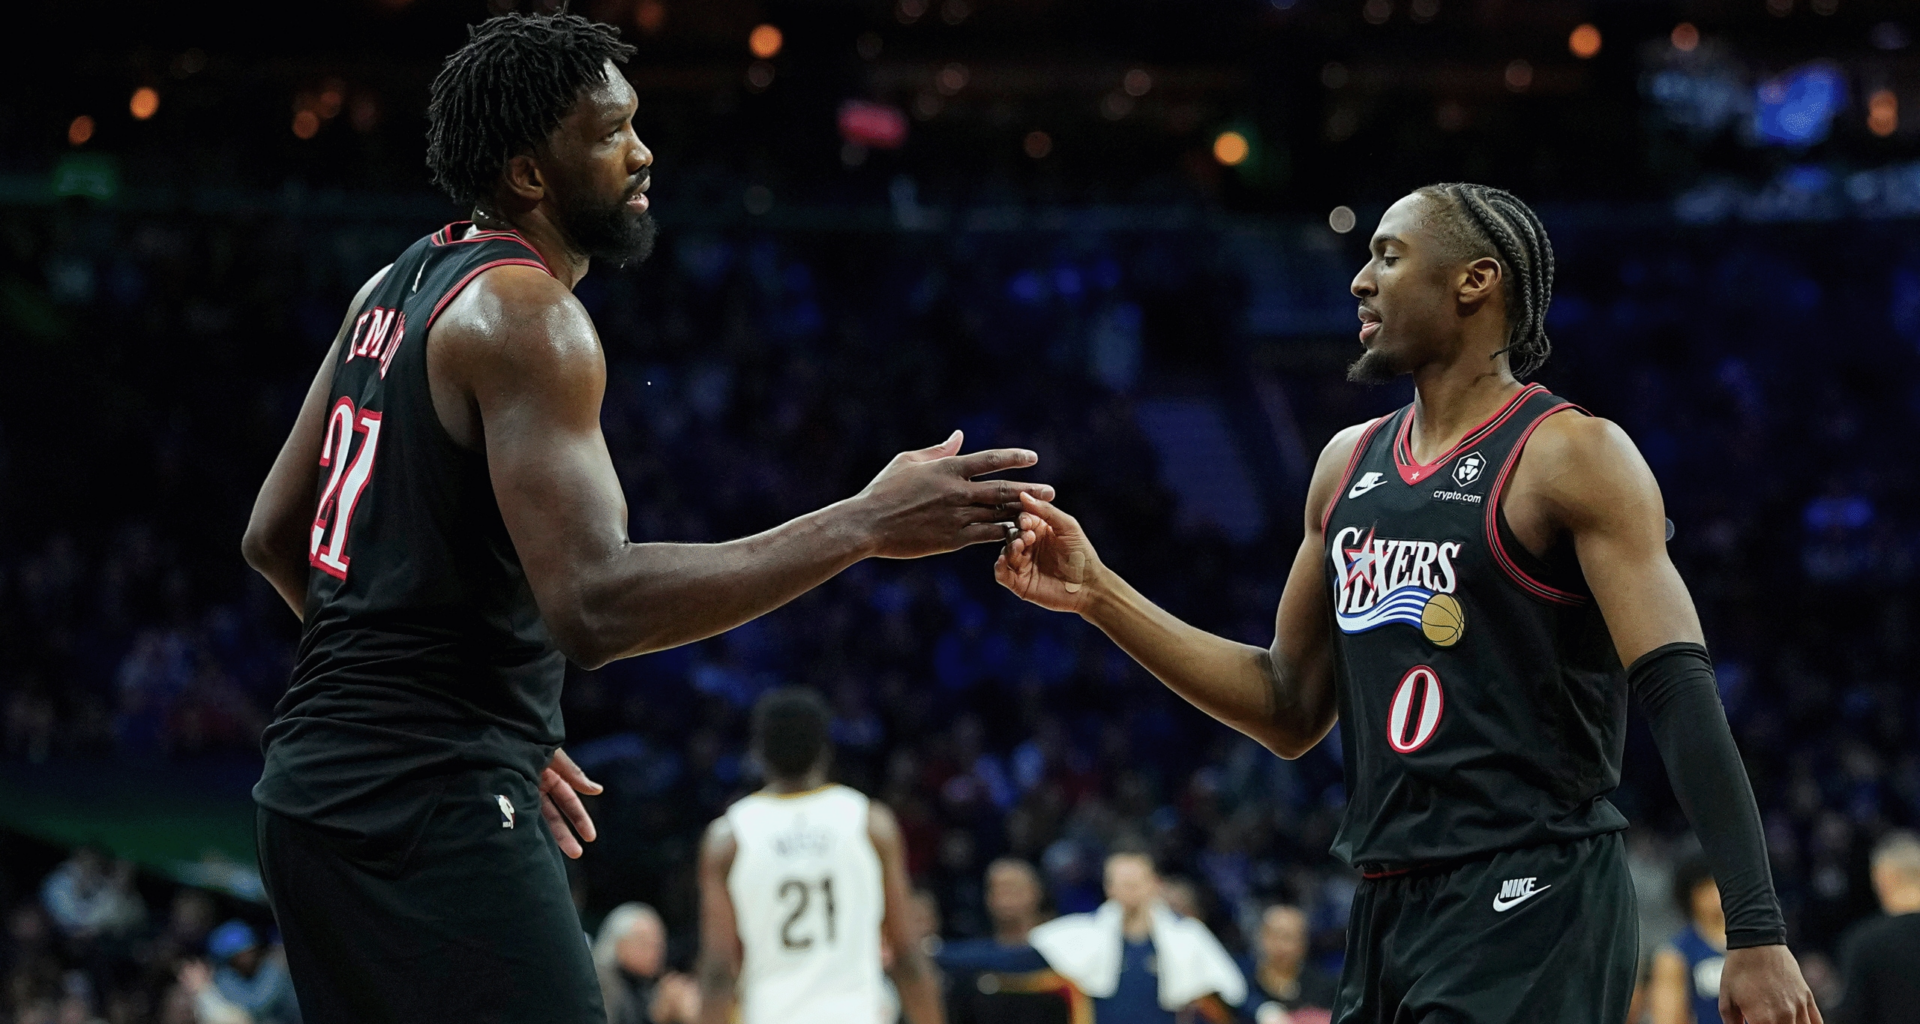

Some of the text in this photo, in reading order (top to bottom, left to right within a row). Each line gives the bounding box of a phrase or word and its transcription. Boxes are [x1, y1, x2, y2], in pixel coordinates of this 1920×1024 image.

[310, 396, 383, 581] 21
[1433, 490, 1482, 504] crypto.com
[1387, 664, 1444, 754] 0
[777, 874, 837, 950] 21
[1499, 876, 1537, 899] NIKE
